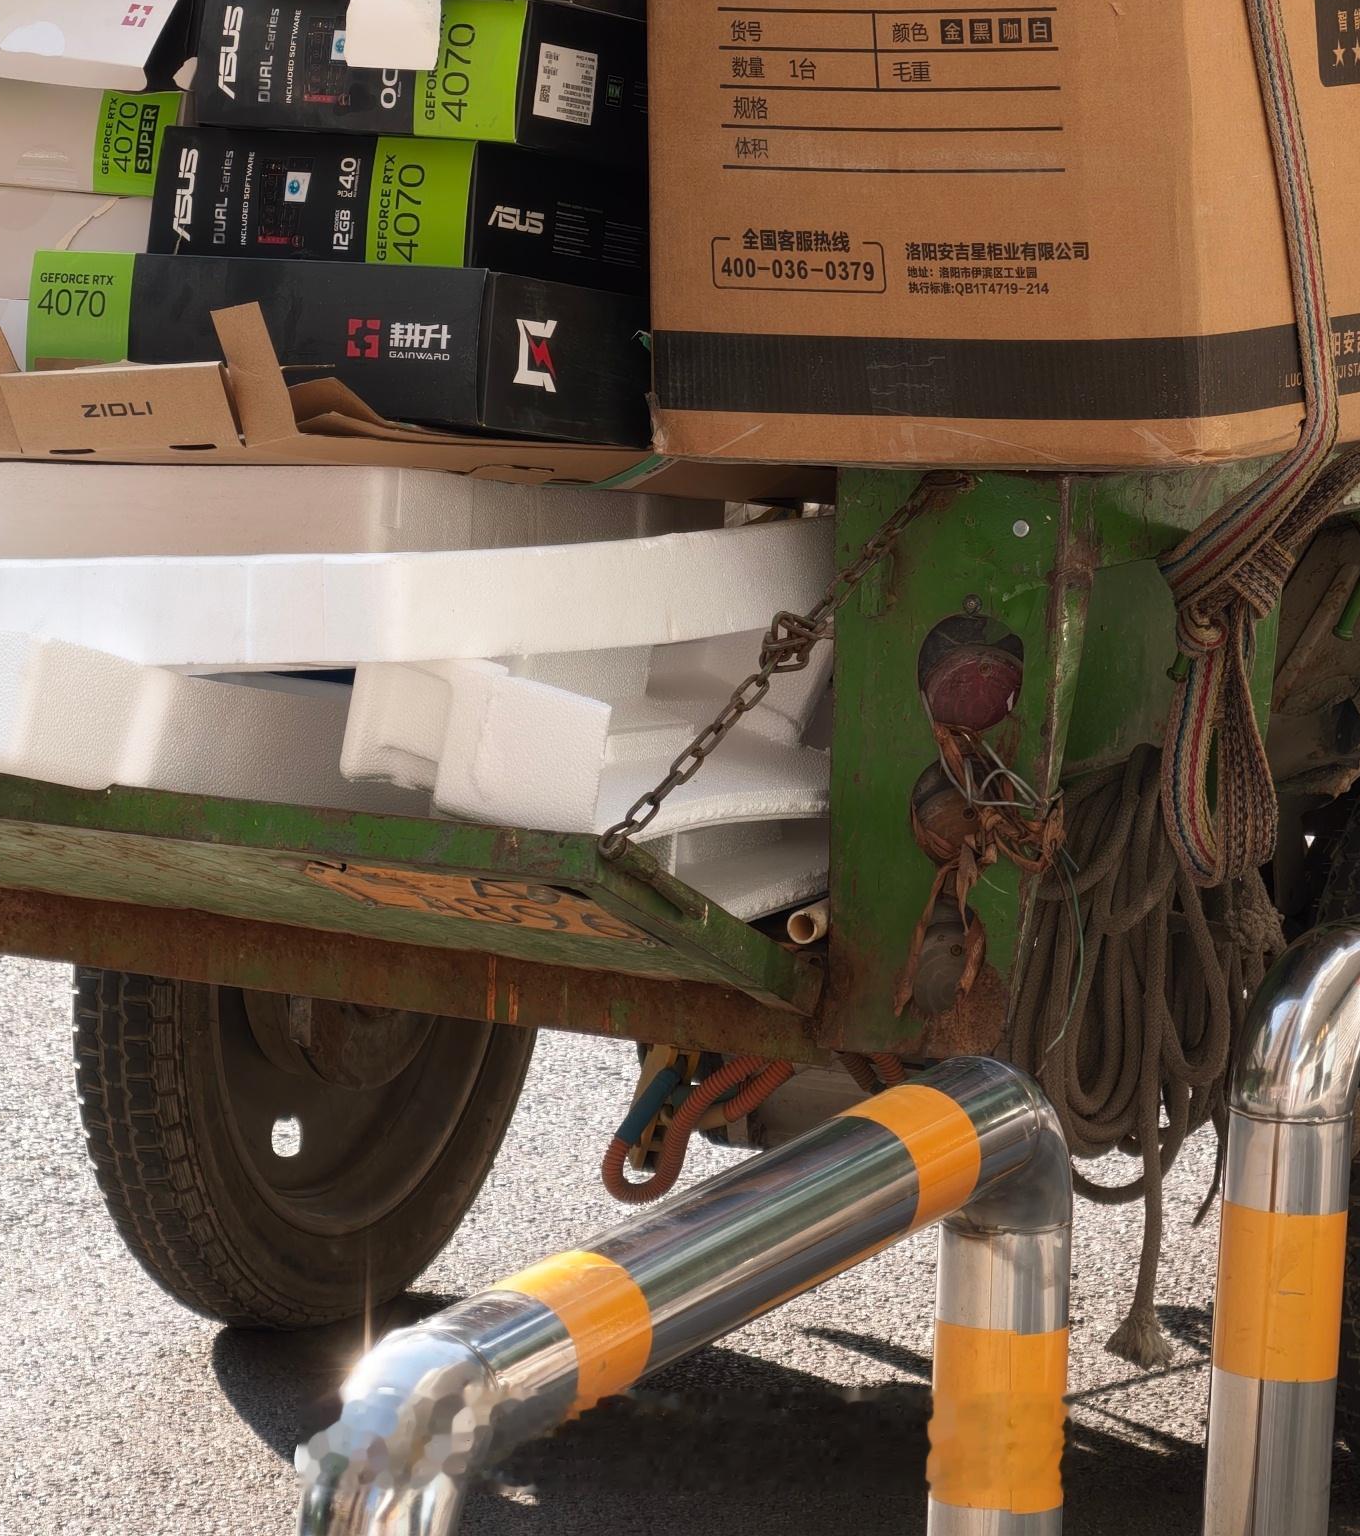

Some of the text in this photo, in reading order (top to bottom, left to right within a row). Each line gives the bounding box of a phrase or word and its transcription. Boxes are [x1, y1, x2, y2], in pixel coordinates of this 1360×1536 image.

[731, 20, 763, 42] 货号
[892, 22, 929, 44] 颜色
[218, 5, 244, 100] ASUS
[258, 8, 280, 103] DUAL Series
[285, 9, 302, 104] INCLUDED SOFTWARE
[442, 23, 475, 122] 4070
[732, 56, 765, 80] 数量
[892, 61, 932, 83] 毛重
[733, 96, 769, 120] 规格
[101, 97, 119, 175] GEFORCE RTX
[113, 101, 139, 172] 4070
[137, 106, 158, 171] SUPER
[735, 137, 769, 159] 体积
[339, 157, 357, 190] 4.0
[172, 147, 200, 242] ASUS
[213, 150, 234, 245] DUAL Series
[240, 151, 256, 246] INCLUDED SOFTWARE
[377, 154, 396, 261] GEFORCE RTX
[392, 163, 425, 263] 4070
[488, 205, 545, 234] ASUS
[332, 209, 351, 251] 12GB
[742, 228, 851, 253] 全国客服热线
[905, 241, 1090, 262] 洛阳安吉星柜业有限公司
[40, 272, 115, 285] GEFORCE RTX
[721, 257, 875, 282] 400-036-0379
[37, 289, 106, 317] 4070
[389, 322, 452, 350] 耕升
[389, 351, 450, 361] GAINWARD
[81, 401, 153, 418] ZIDLI
